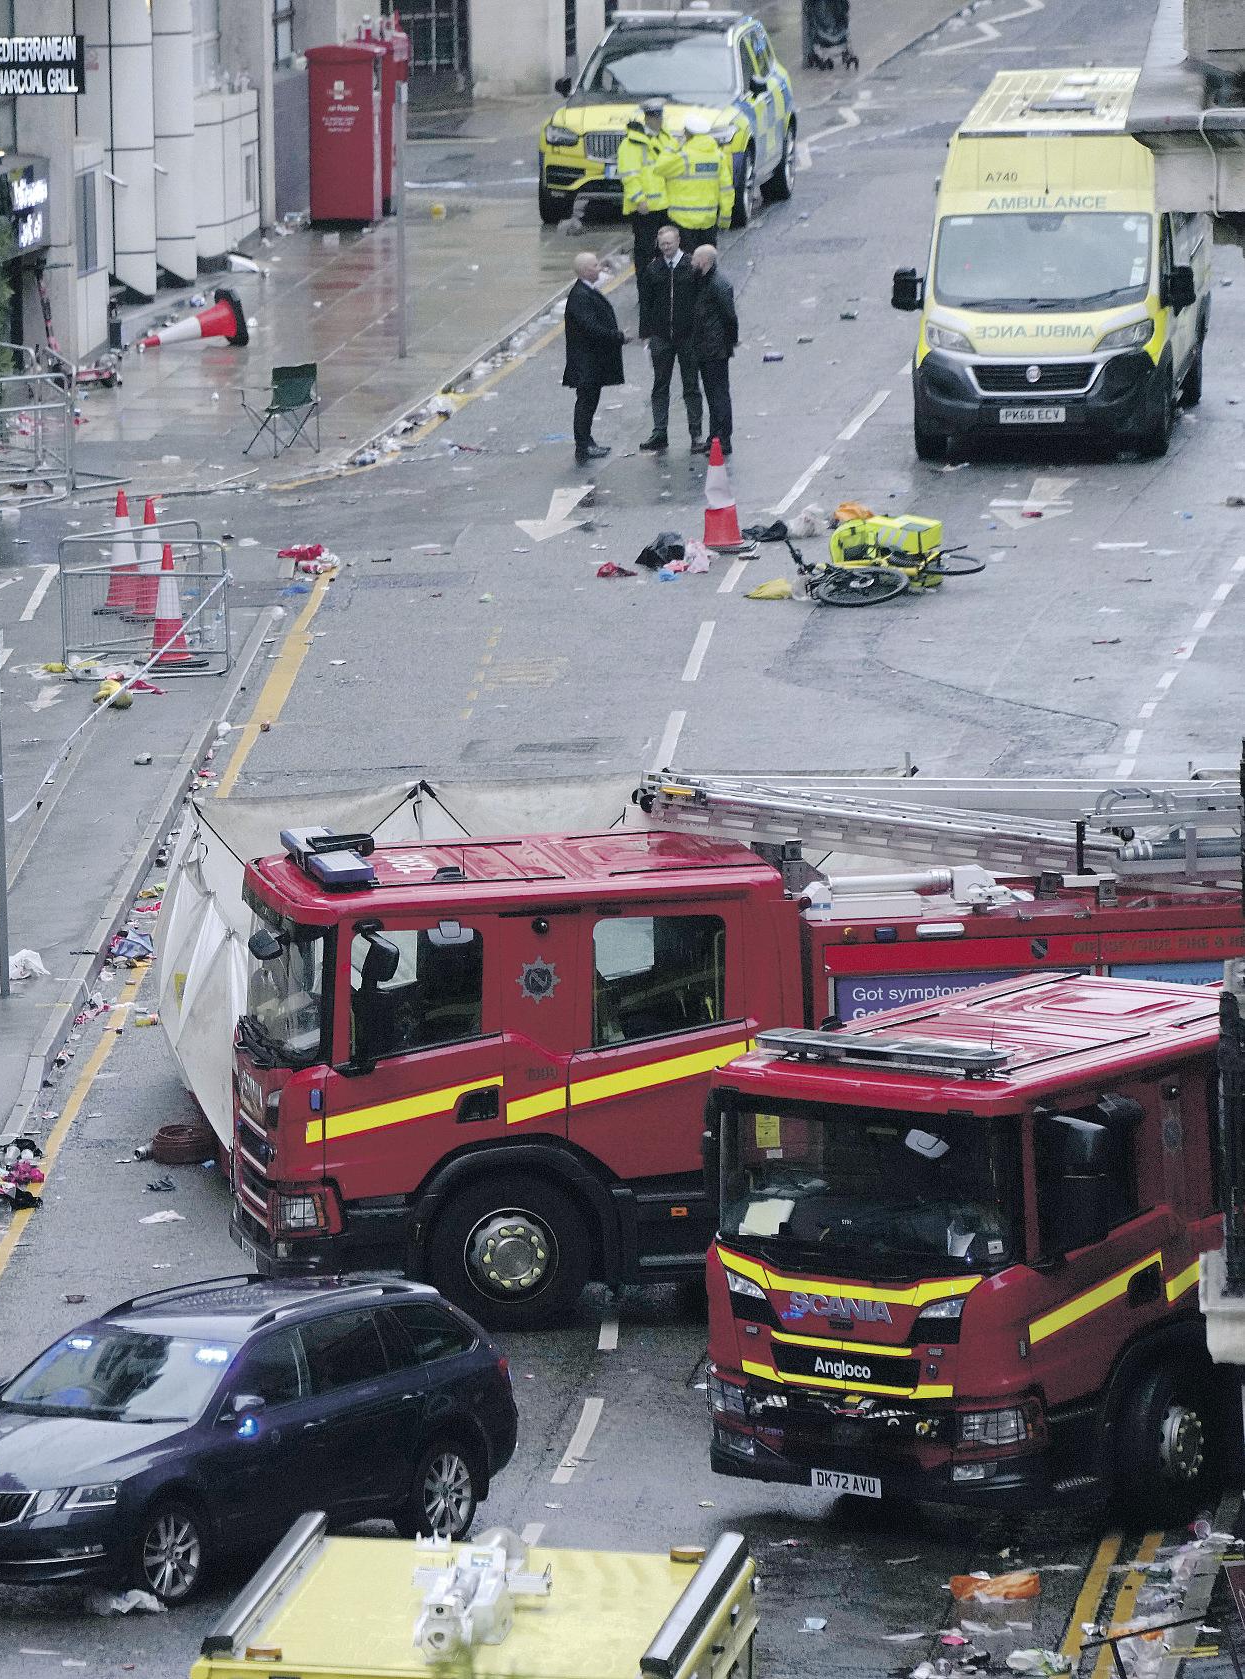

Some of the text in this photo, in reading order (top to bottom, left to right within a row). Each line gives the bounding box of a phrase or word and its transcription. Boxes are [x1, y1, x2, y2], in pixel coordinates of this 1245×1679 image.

[47, 68, 79, 93] GRILL
[985, 172, 1018, 182] A740
[986, 196, 1107, 210] AMBULANCE
[1005, 410, 1060, 421] PK66 ECV
[852, 987, 884, 1001] Got
[789, 1292, 893, 1325] SCANIA
[814, 1357, 871, 1380] Angloco
[816, 1472, 877, 1494] DK72 AVU
